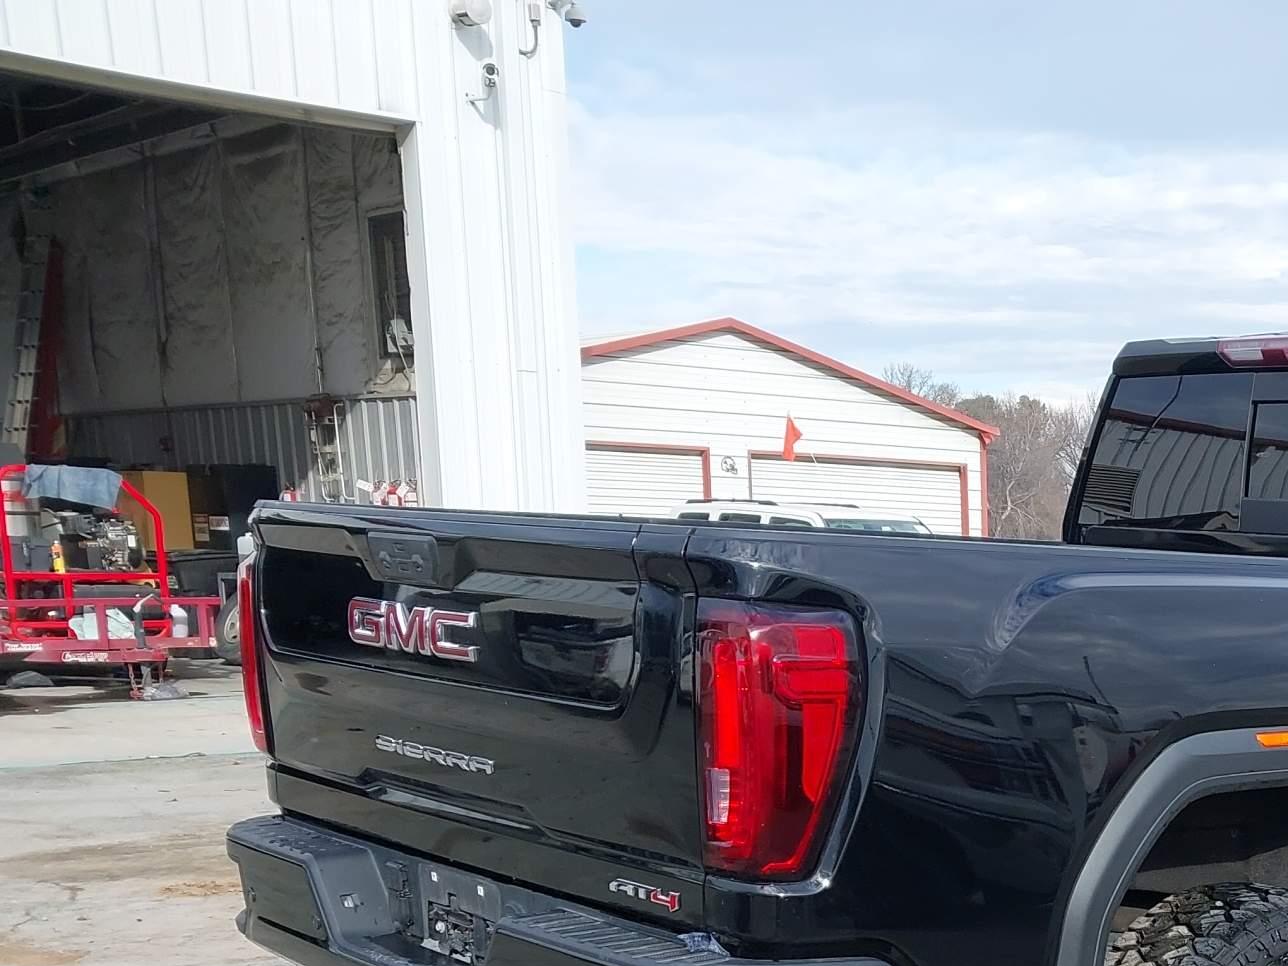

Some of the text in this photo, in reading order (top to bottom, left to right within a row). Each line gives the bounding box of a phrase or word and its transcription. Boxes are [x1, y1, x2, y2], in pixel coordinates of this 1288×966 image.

[347, 596, 480, 663] GMC
[375, 734, 495, 775] SIERRA
[608, 878, 680, 913] AT4
